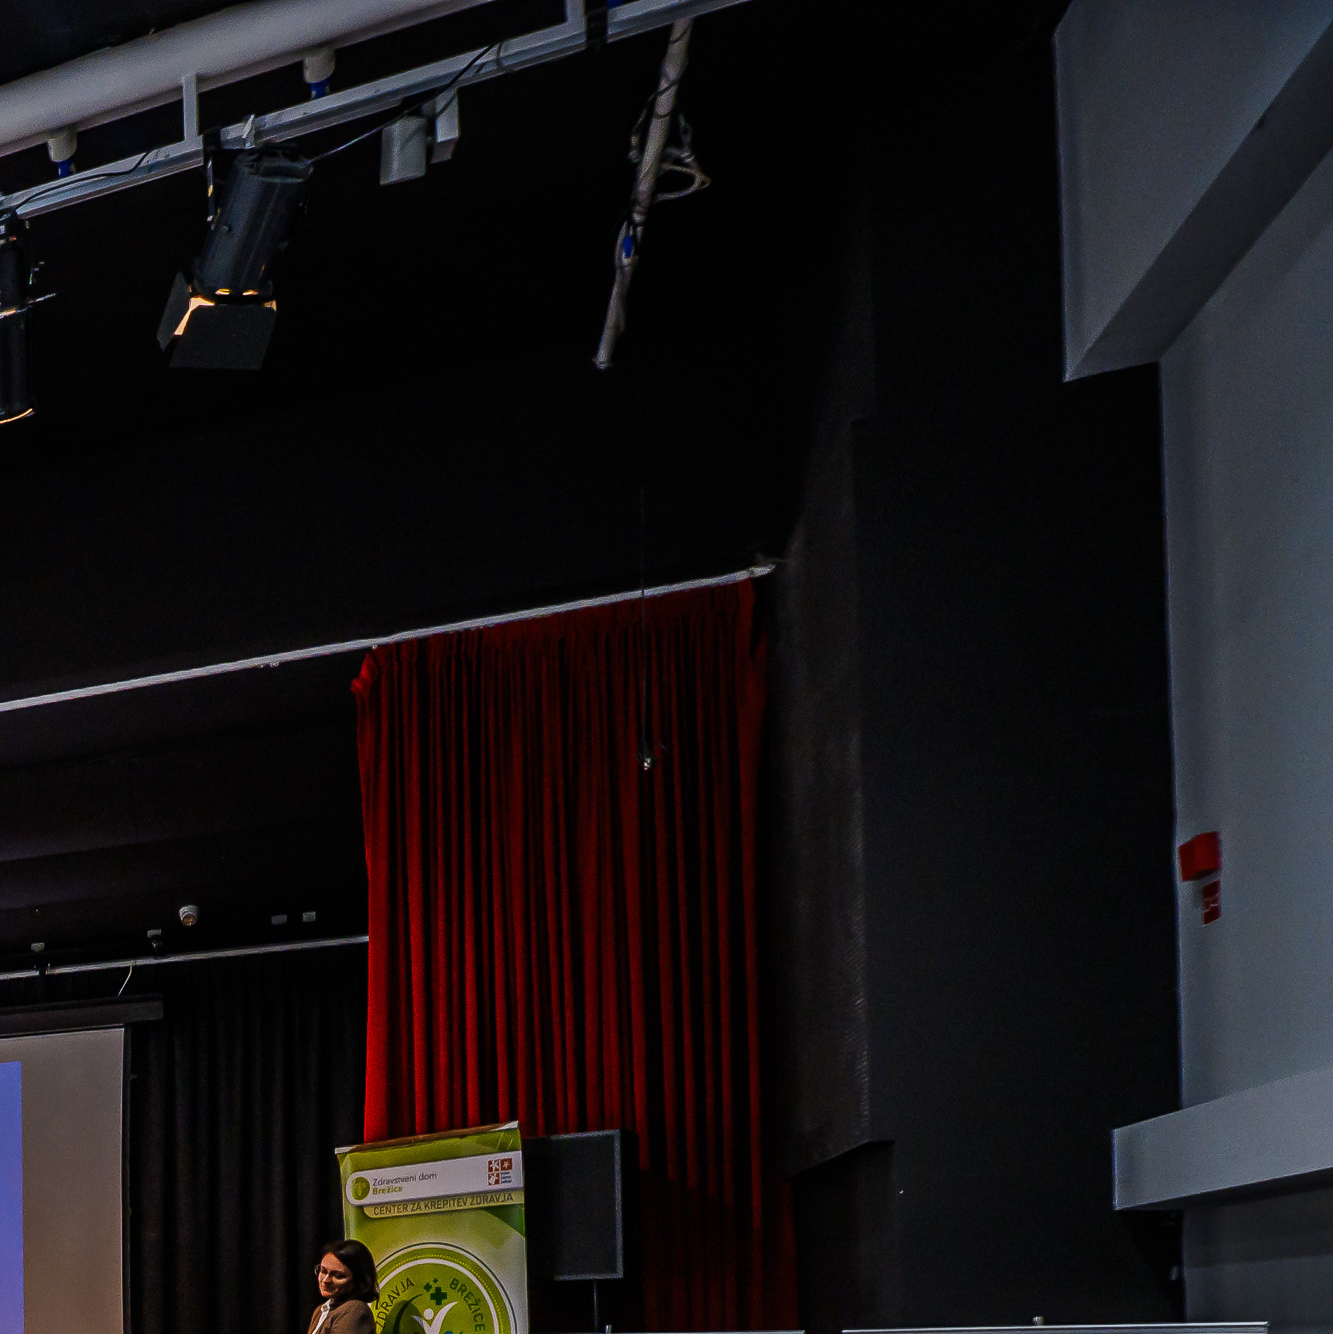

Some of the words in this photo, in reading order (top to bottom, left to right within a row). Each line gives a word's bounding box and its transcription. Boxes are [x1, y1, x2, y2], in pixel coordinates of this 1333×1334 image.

[372, 1176, 417, 1187] Zdravstveni
[418, 1172, 437, 1180] dom
[373, 1202, 409, 1216] CENTER
[411, 1201, 422, 1212] ZA
[424, 1196, 468, 1211] KREPITEV
[470, 1191, 514, 1207] ZDRAVJA
[376, 1277, 415, 1328] ZDRAVJA
